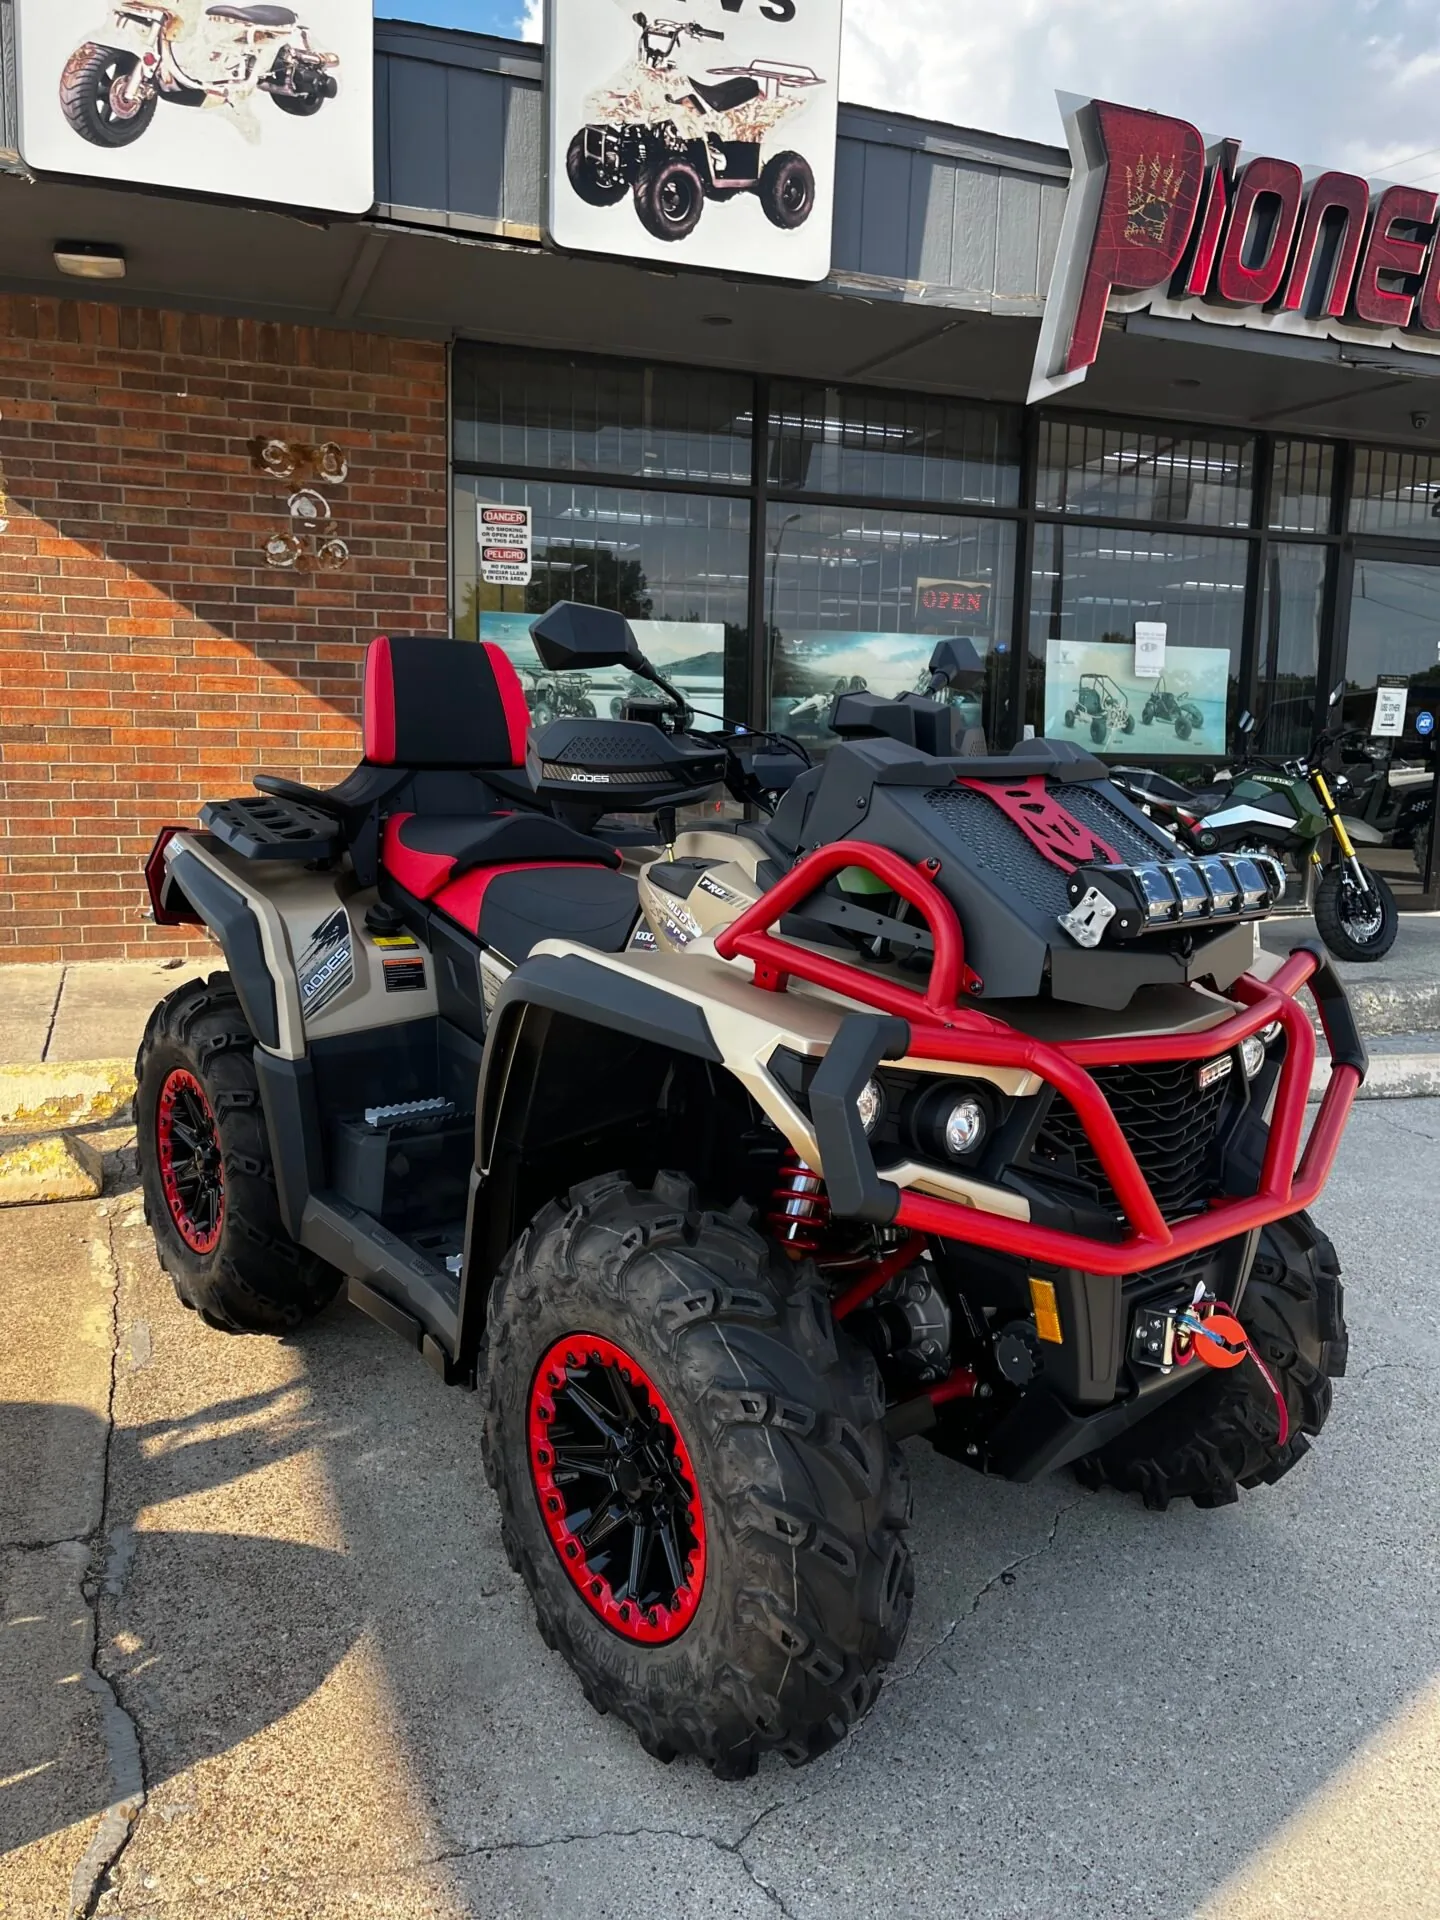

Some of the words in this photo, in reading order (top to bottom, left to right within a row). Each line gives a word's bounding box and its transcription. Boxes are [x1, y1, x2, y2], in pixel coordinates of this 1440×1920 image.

[486, 512, 523, 522] DANGER
[487, 550, 523, 559] PELIGRO
[922, 590, 982, 610] OPEN
[571, 773, 610, 783] AODES
[700, 878, 726, 897] PRO
[666, 899, 688, 925] MUD
[635, 931, 655, 942] 1000
[666, 919, 688, 942] Pro
[303, 947, 349, 997] AODES
